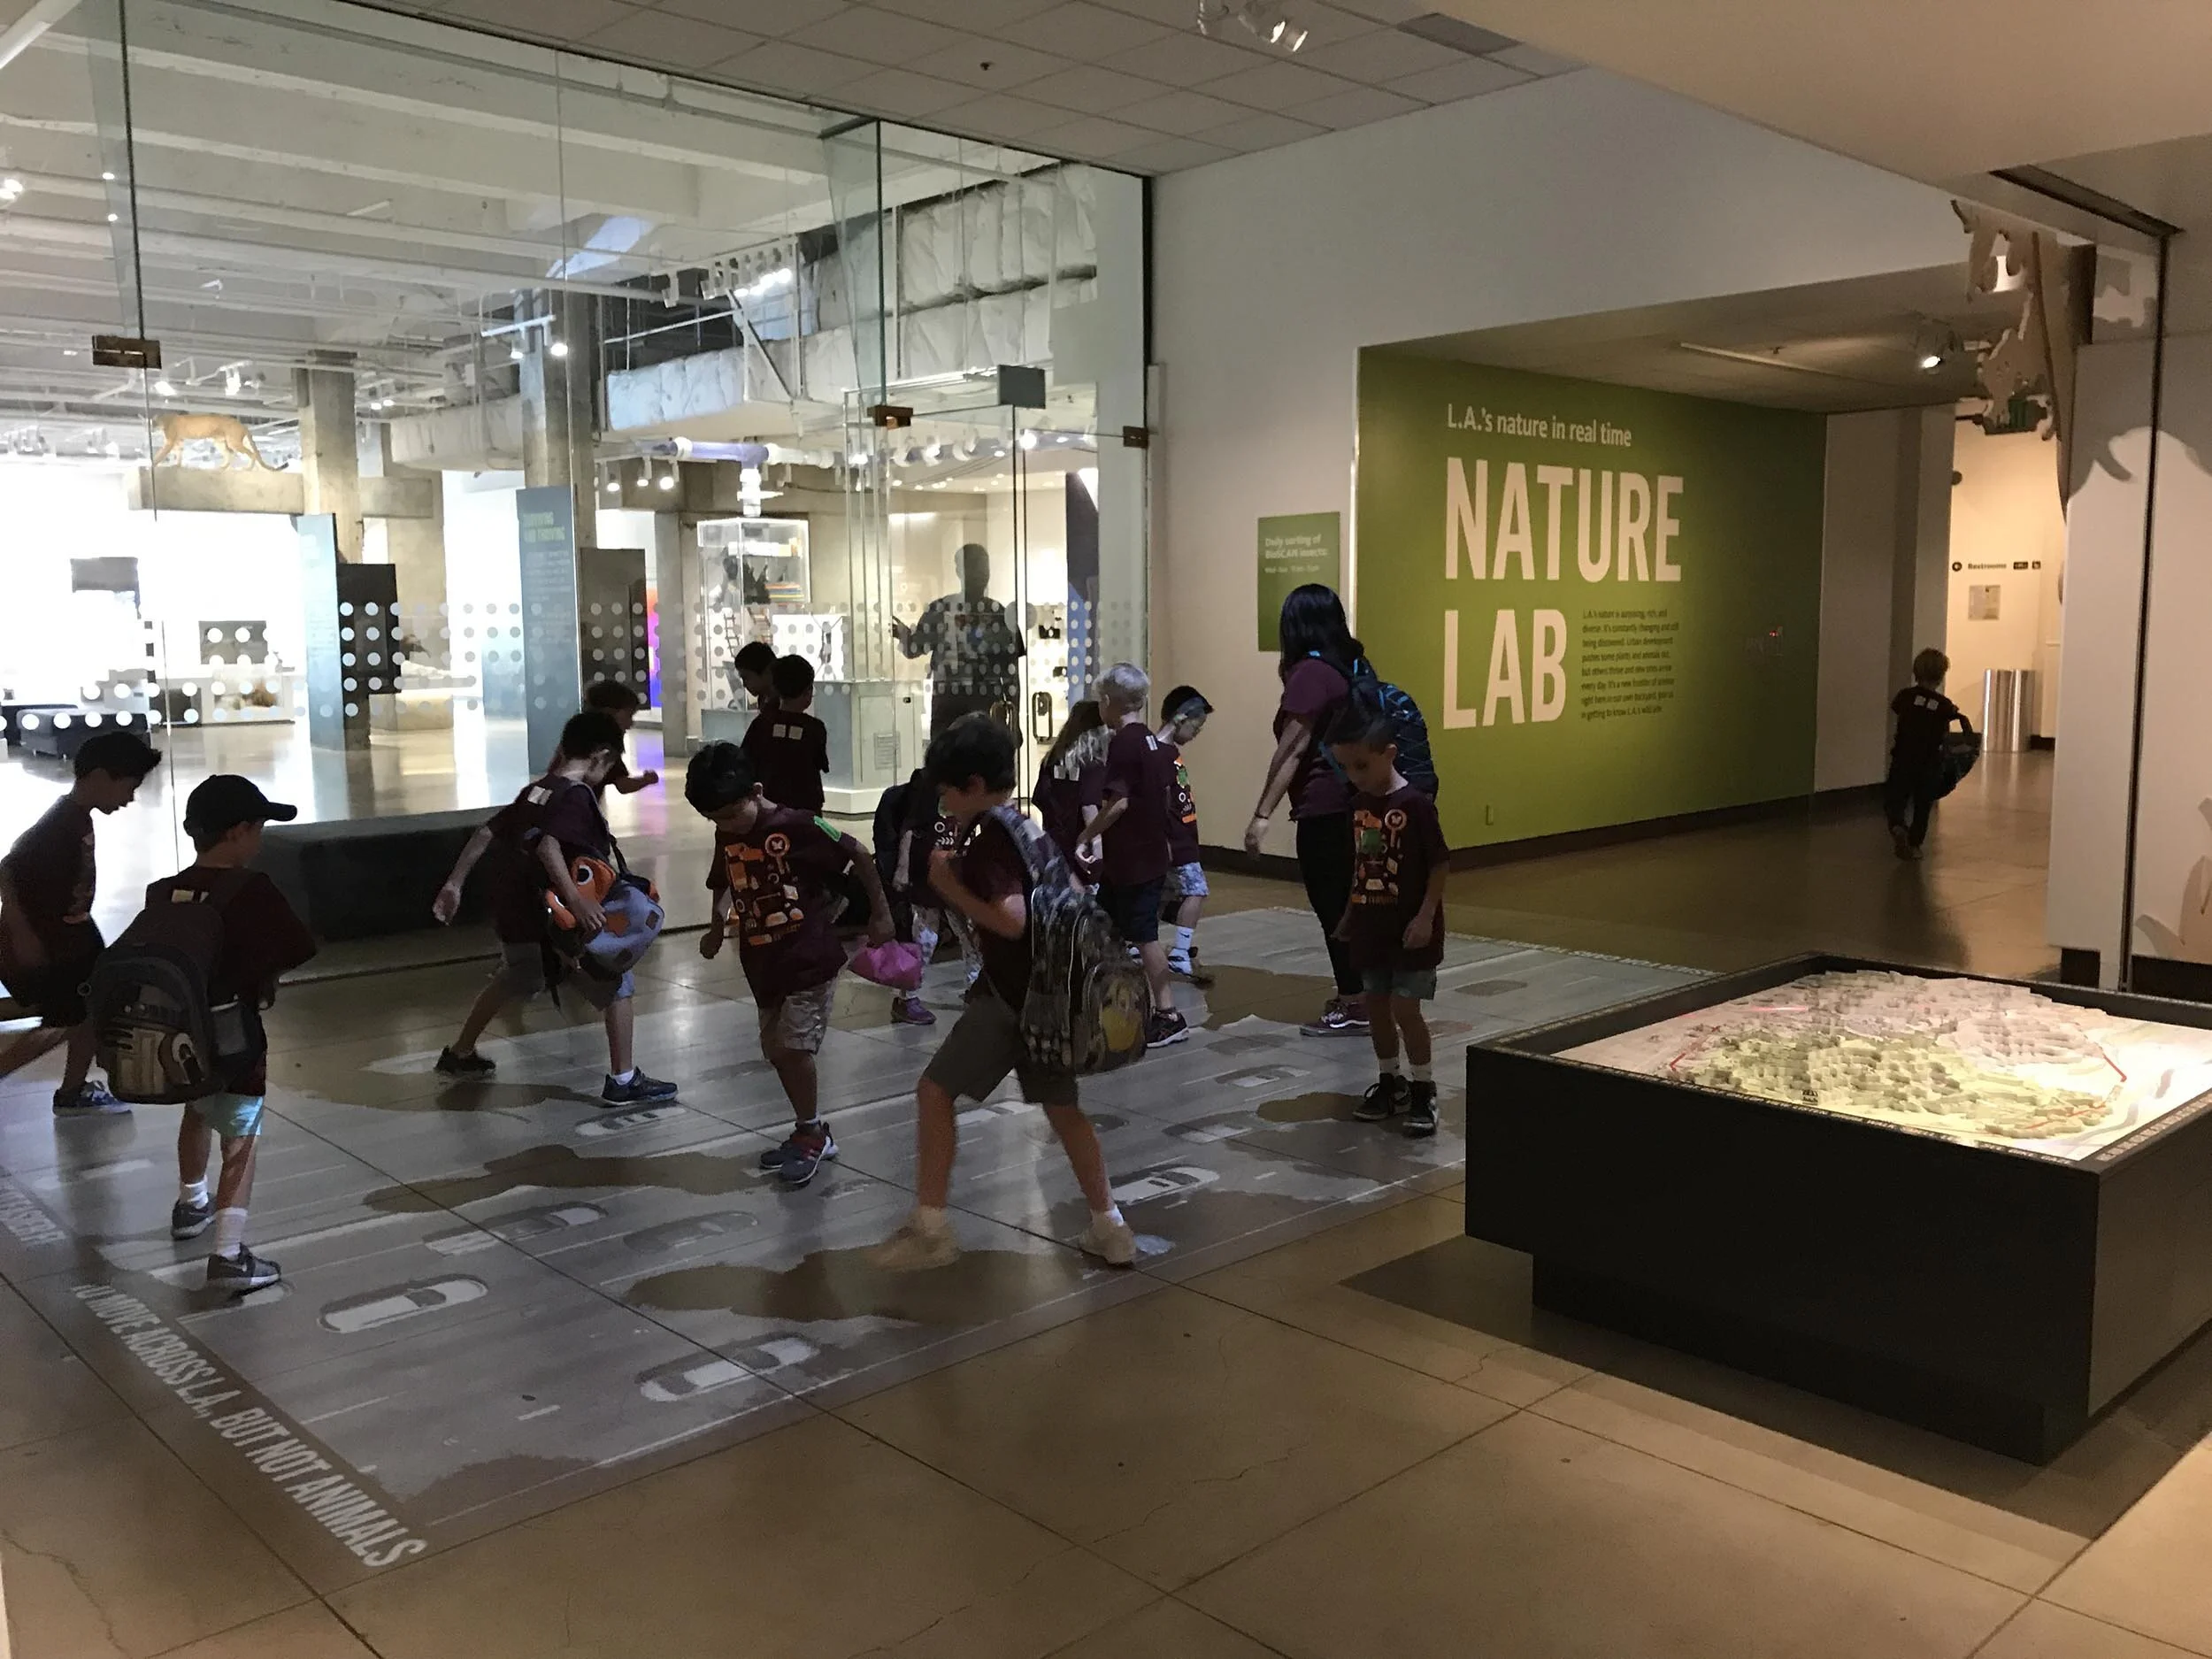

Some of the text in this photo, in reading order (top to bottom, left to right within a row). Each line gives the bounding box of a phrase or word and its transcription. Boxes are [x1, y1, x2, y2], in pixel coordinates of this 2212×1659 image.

[1448, 403, 1632, 448] L.A.'s nature in real time
[1312, 534, 1322, 545] of
[1445, 457, 1684, 582] NATURE
[1443, 609, 1567, 730] LAB
[120, 1325, 217, 1387] ACROSS
[210, 1408, 290, 1448] BUT
[245, 1437, 333, 1482] NOT
[285, 1474, 429, 1568] ANIMALS
